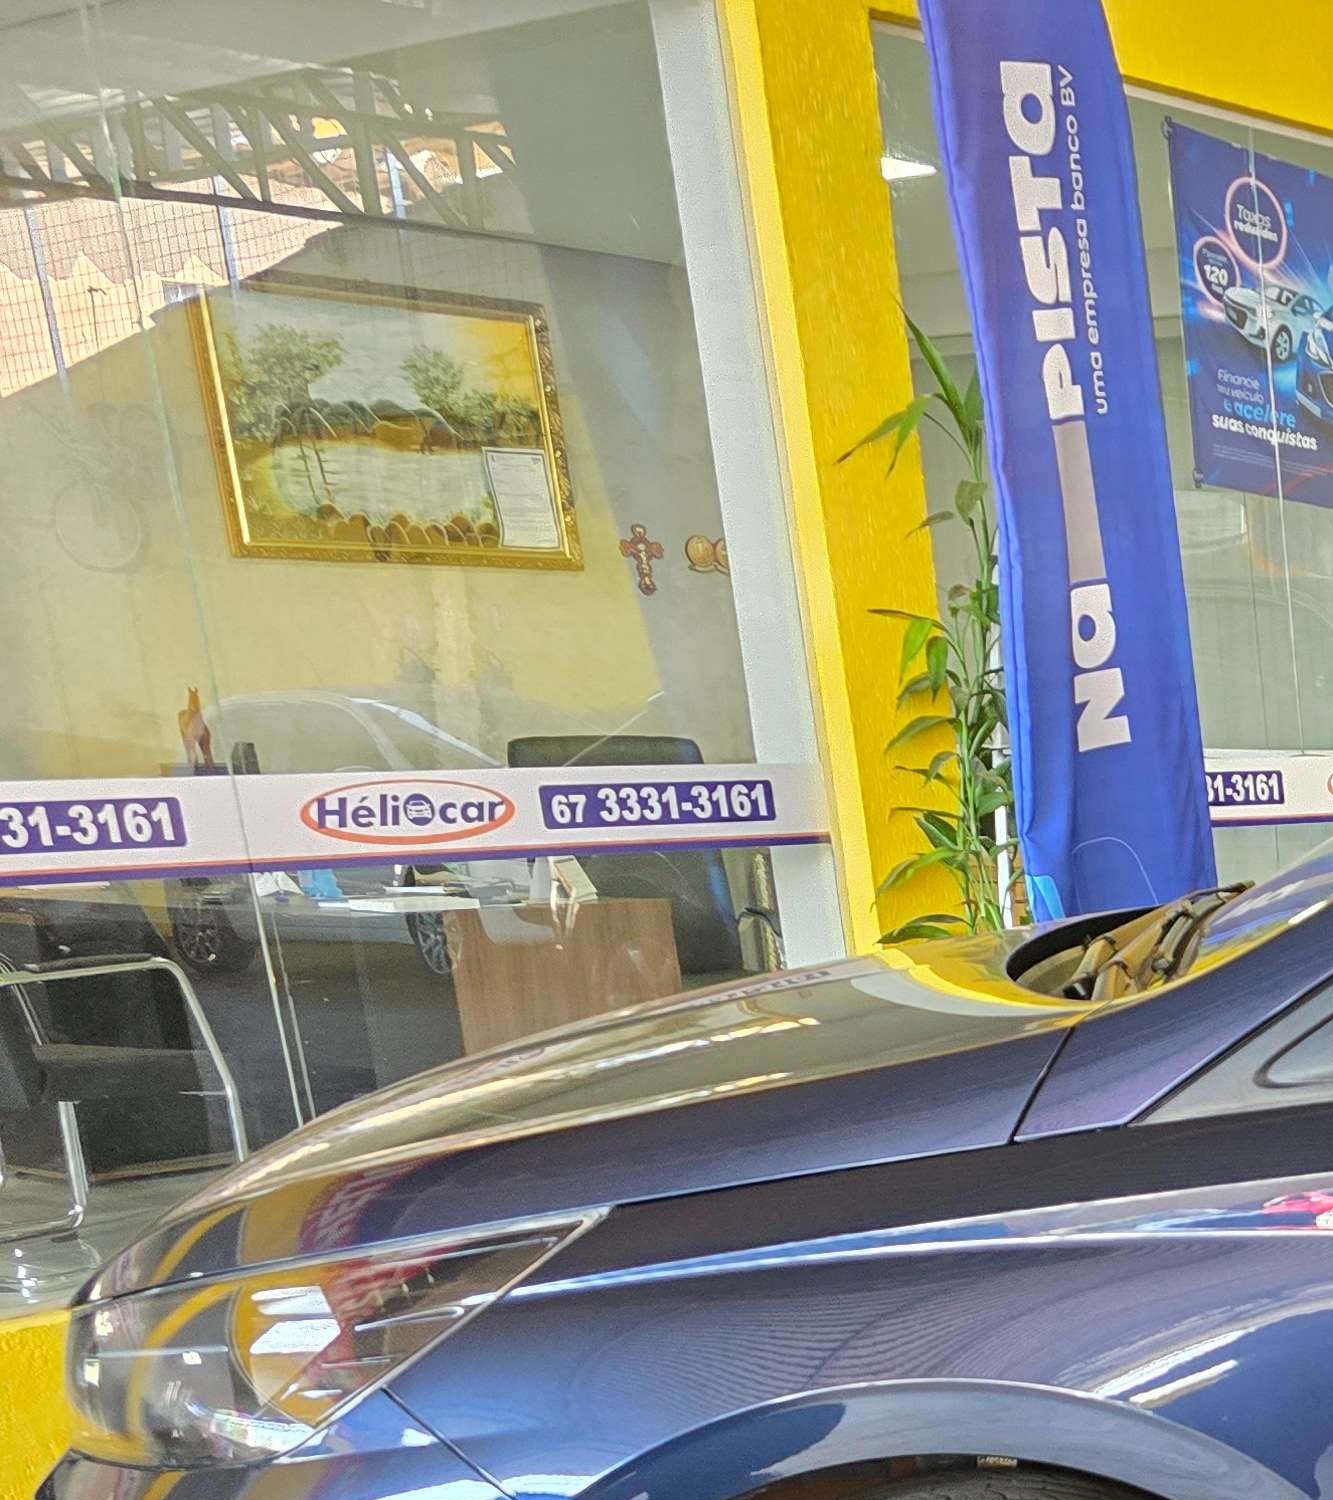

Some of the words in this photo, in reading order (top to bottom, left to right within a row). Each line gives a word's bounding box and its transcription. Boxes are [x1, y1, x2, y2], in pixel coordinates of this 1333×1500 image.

[1057, 65, 1077, 105] BV
[1065, 117, 1086, 210] banco
[1075, 218, 1100, 341] empresa
[1204, 264, 1228, 286] 120
[1090, 354, 1108, 414] uma
[1217, 369, 1260, 389] Financie
[1212, 414, 1245, 434] suas
[1245, 422, 1318, 451] conquistas
[0, 802, 175, 848] 31-3161
[551, 794, 586, 825] 67
[600, 784, 769, 822] 3331-3161
